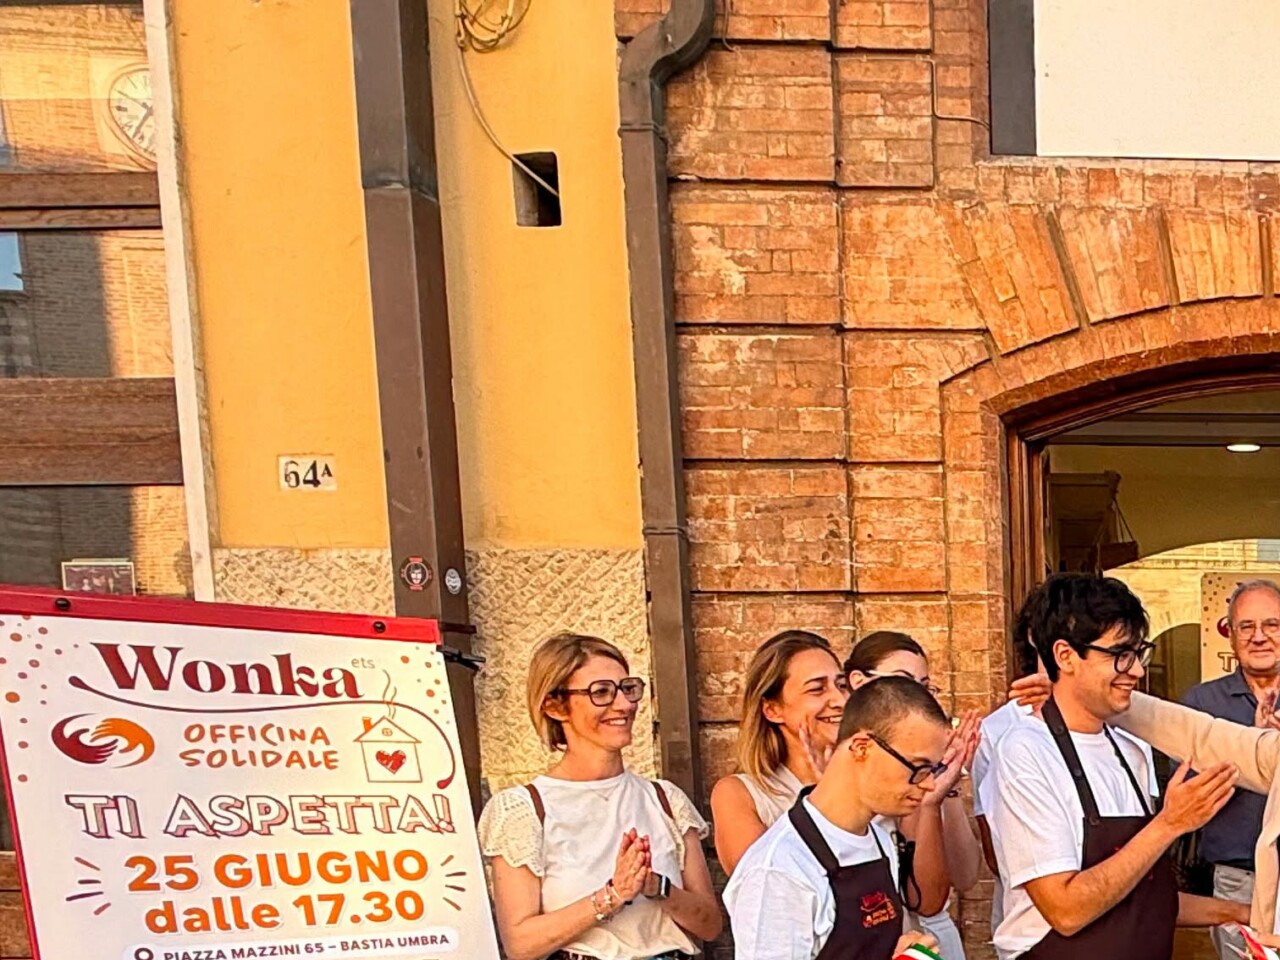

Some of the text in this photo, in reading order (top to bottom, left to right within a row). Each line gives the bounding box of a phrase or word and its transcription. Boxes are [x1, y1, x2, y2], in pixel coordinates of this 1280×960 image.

[90, 642, 365, 698] Wonka
[351, 656, 375, 670] ets
[184, 723, 330, 746] OFFICINA
[179, 749, 339, 769] SOLIDALE
[64, 792, 457, 839] TI ASPETTA!
[124, 849, 429, 893] 25 GIUGNO
[144, 890, 425, 934] dalle 17.30
[231, 945, 301, 959] MAZZINI
[304, 942, 325, 954] 65
[341, 938, 394, 952] BASTIA
[398, 933, 449, 948] UMBRA
